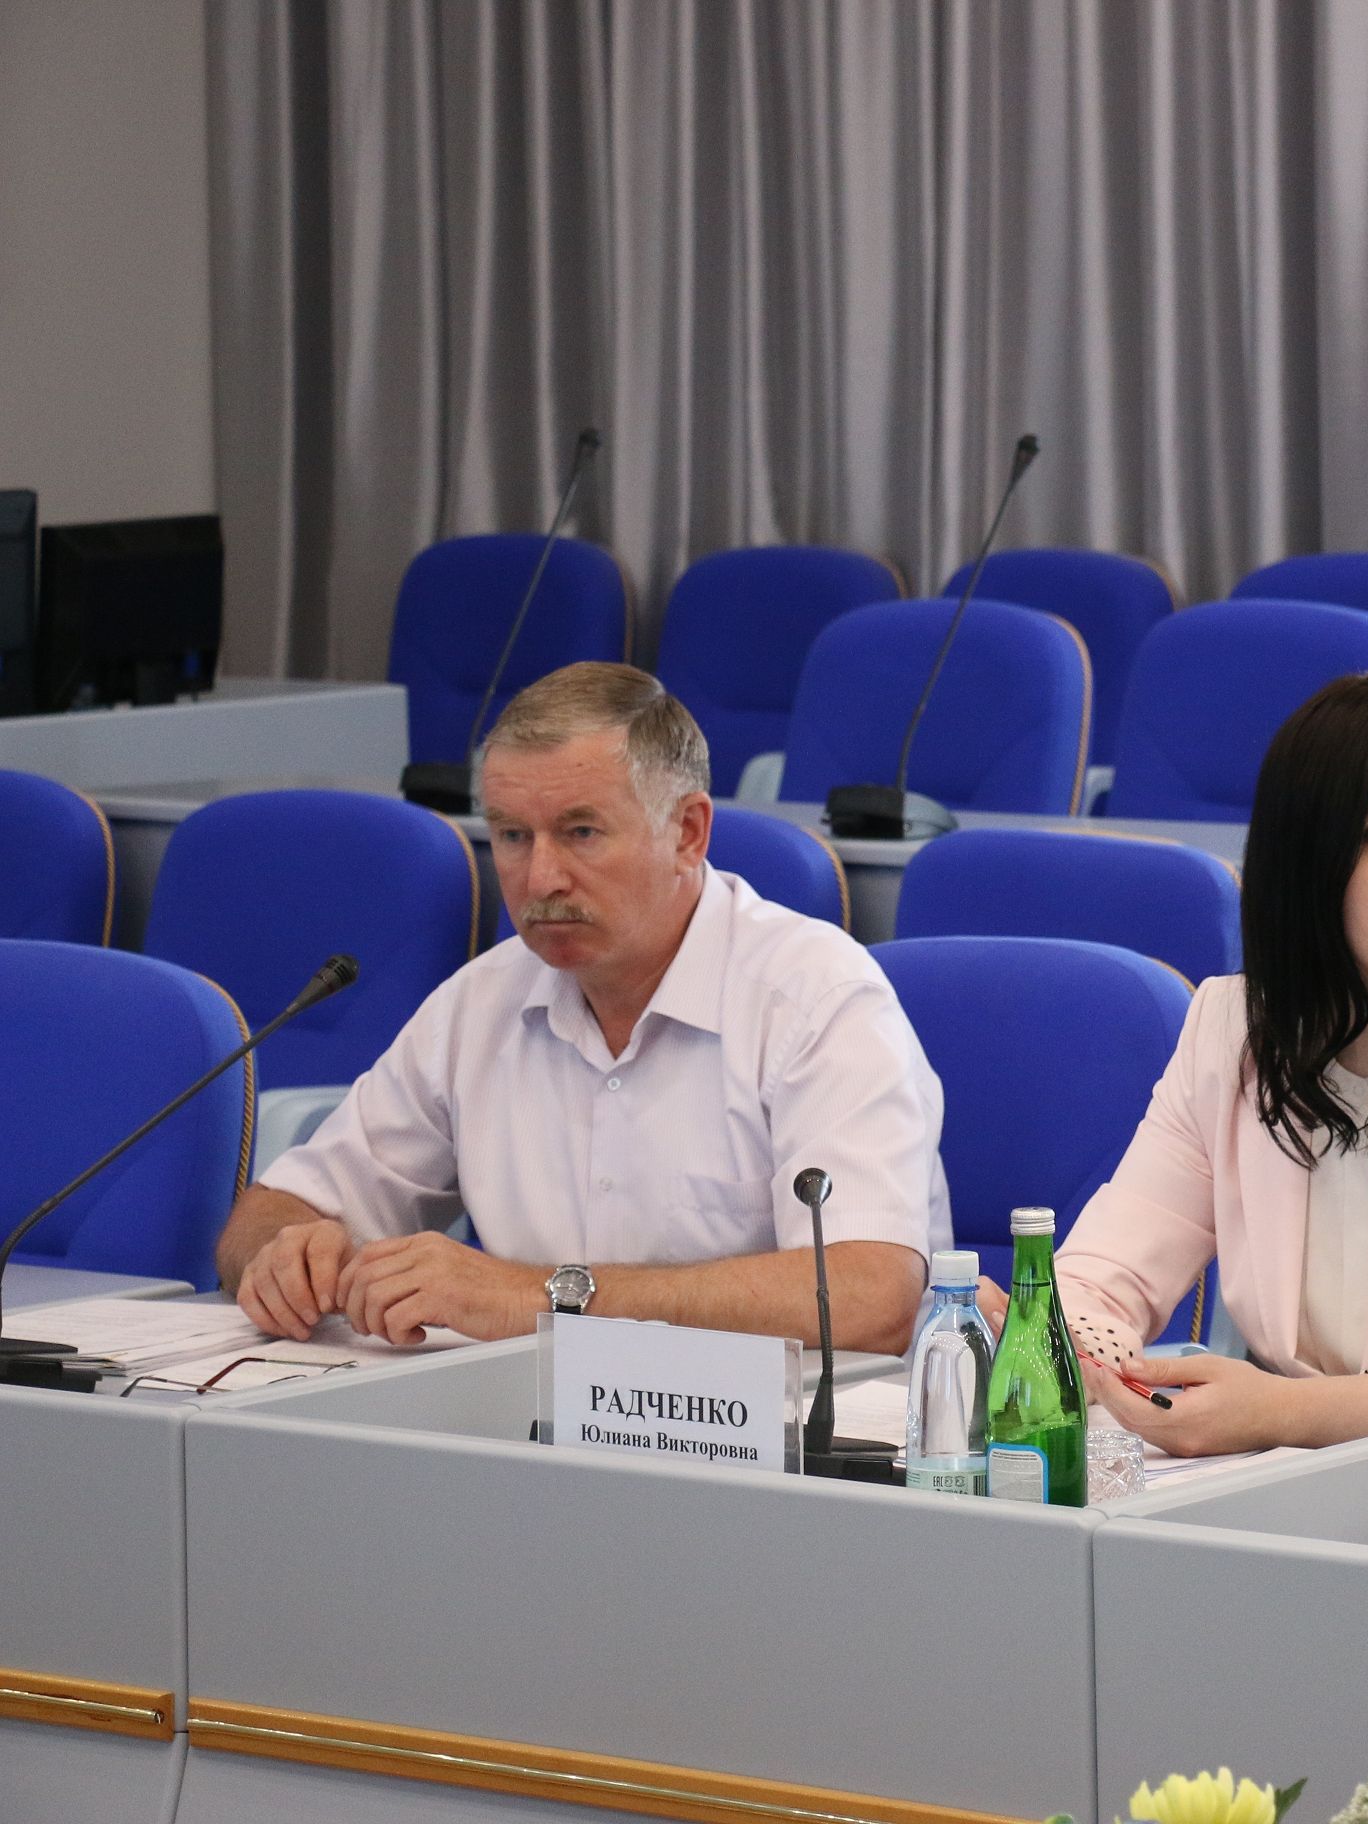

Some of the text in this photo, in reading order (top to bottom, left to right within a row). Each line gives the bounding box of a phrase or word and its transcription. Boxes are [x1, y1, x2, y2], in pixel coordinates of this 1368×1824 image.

[590, 1385, 748, 1428] РАДЧЕНКО
[581, 1424, 758, 1461] Юлиана Викторовна
